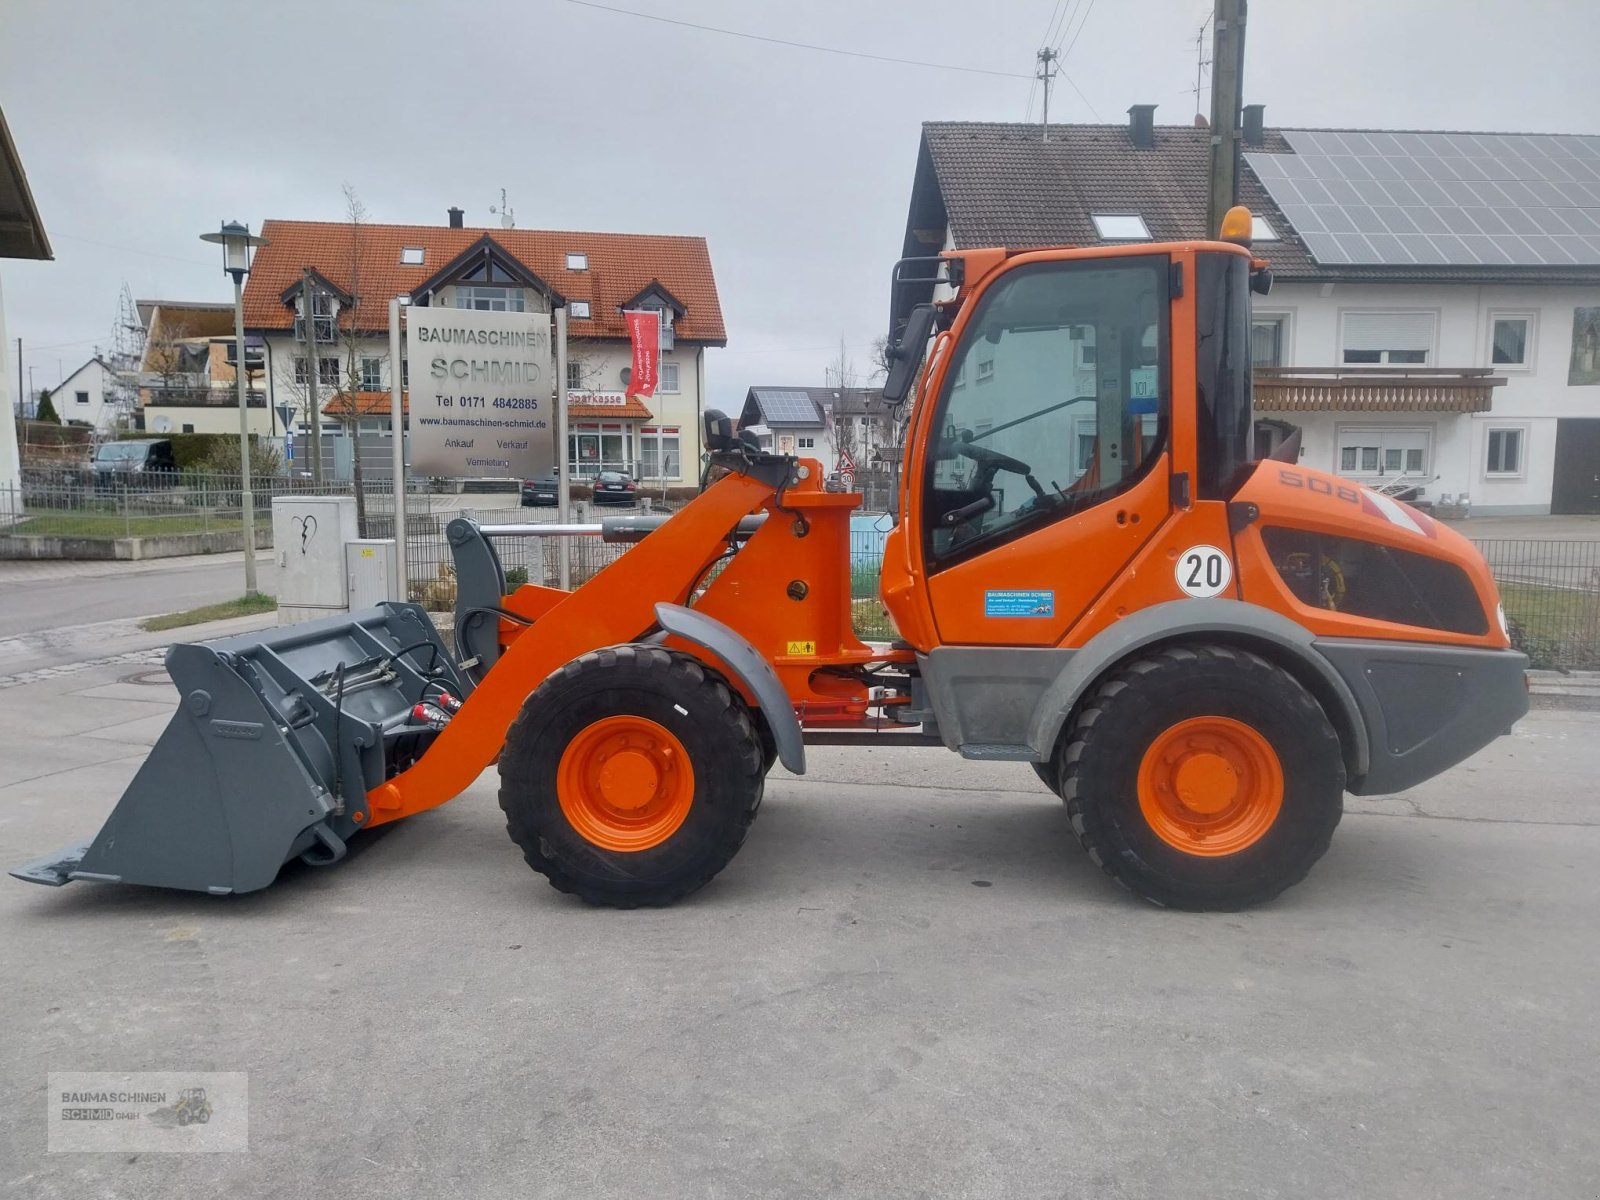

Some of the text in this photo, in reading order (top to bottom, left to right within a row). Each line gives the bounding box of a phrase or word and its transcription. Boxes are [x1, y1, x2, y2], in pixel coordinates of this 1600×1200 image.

[418, 327, 547, 346] BAUMASCHINEN
[430, 358, 541, 382] SCHMID
[1134, 381, 1147, 395] 101
[435, 395, 538, 410] Tel 0171 4842885
[568, 393, 621, 405] Sparkasse
[419, 416, 547, 429] www.baumaschinen-schmid.de
[444, 438, 528, 449] Ankauf Verkauf
[465, 457, 510, 469] Vermietung
[842, 475, 852, 483] 30
[1279, 469, 1360, 504] 508
[1186, 554, 1222, 588] 20
